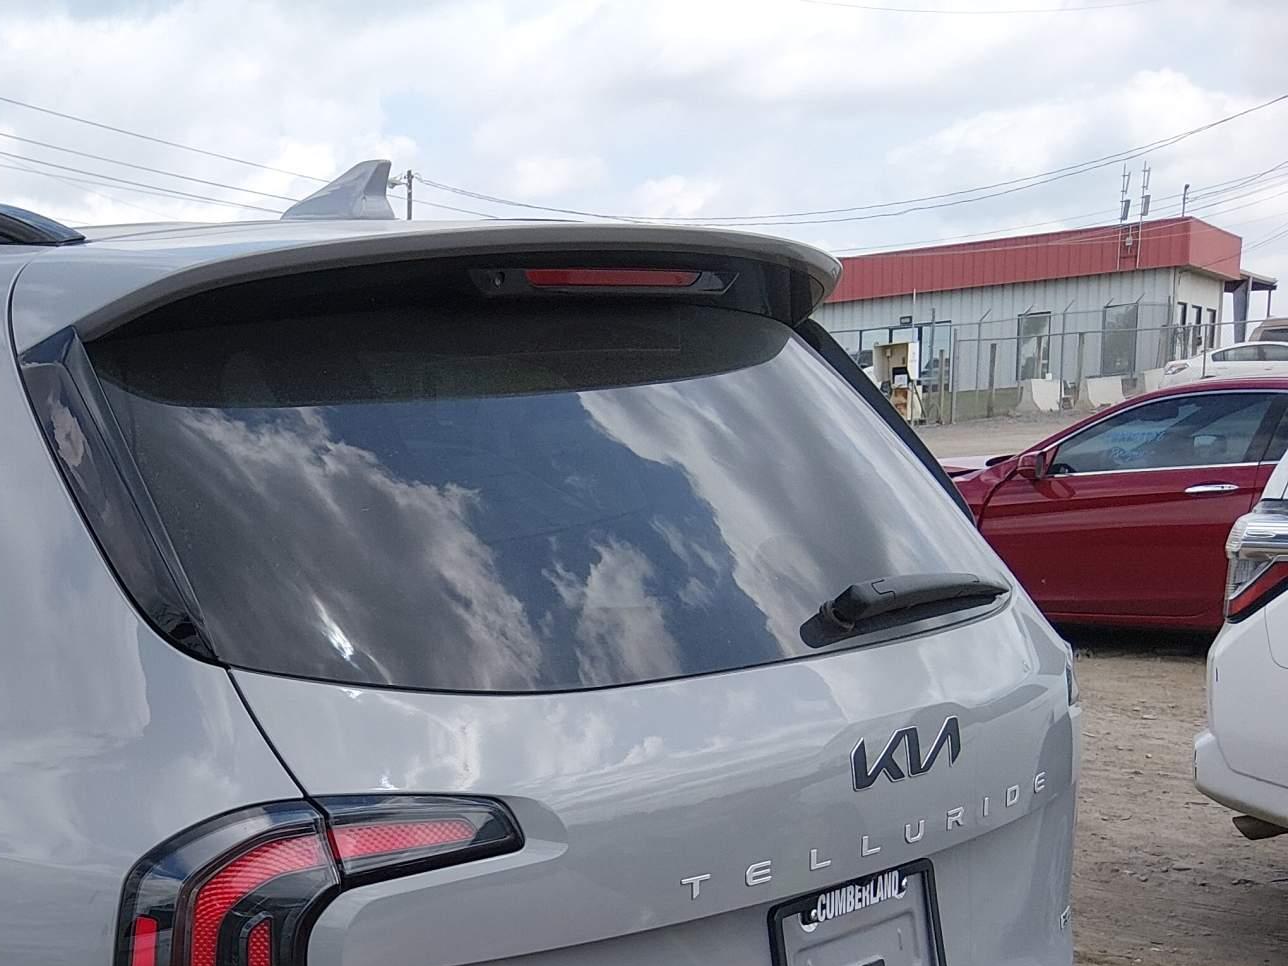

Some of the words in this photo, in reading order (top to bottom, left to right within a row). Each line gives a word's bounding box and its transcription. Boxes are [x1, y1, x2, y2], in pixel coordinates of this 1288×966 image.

[850, 715, 961, 791] KIA
[680, 771, 1046, 899] TELLURIDE
[817, 870, 900, 922] CUMBERLAND
